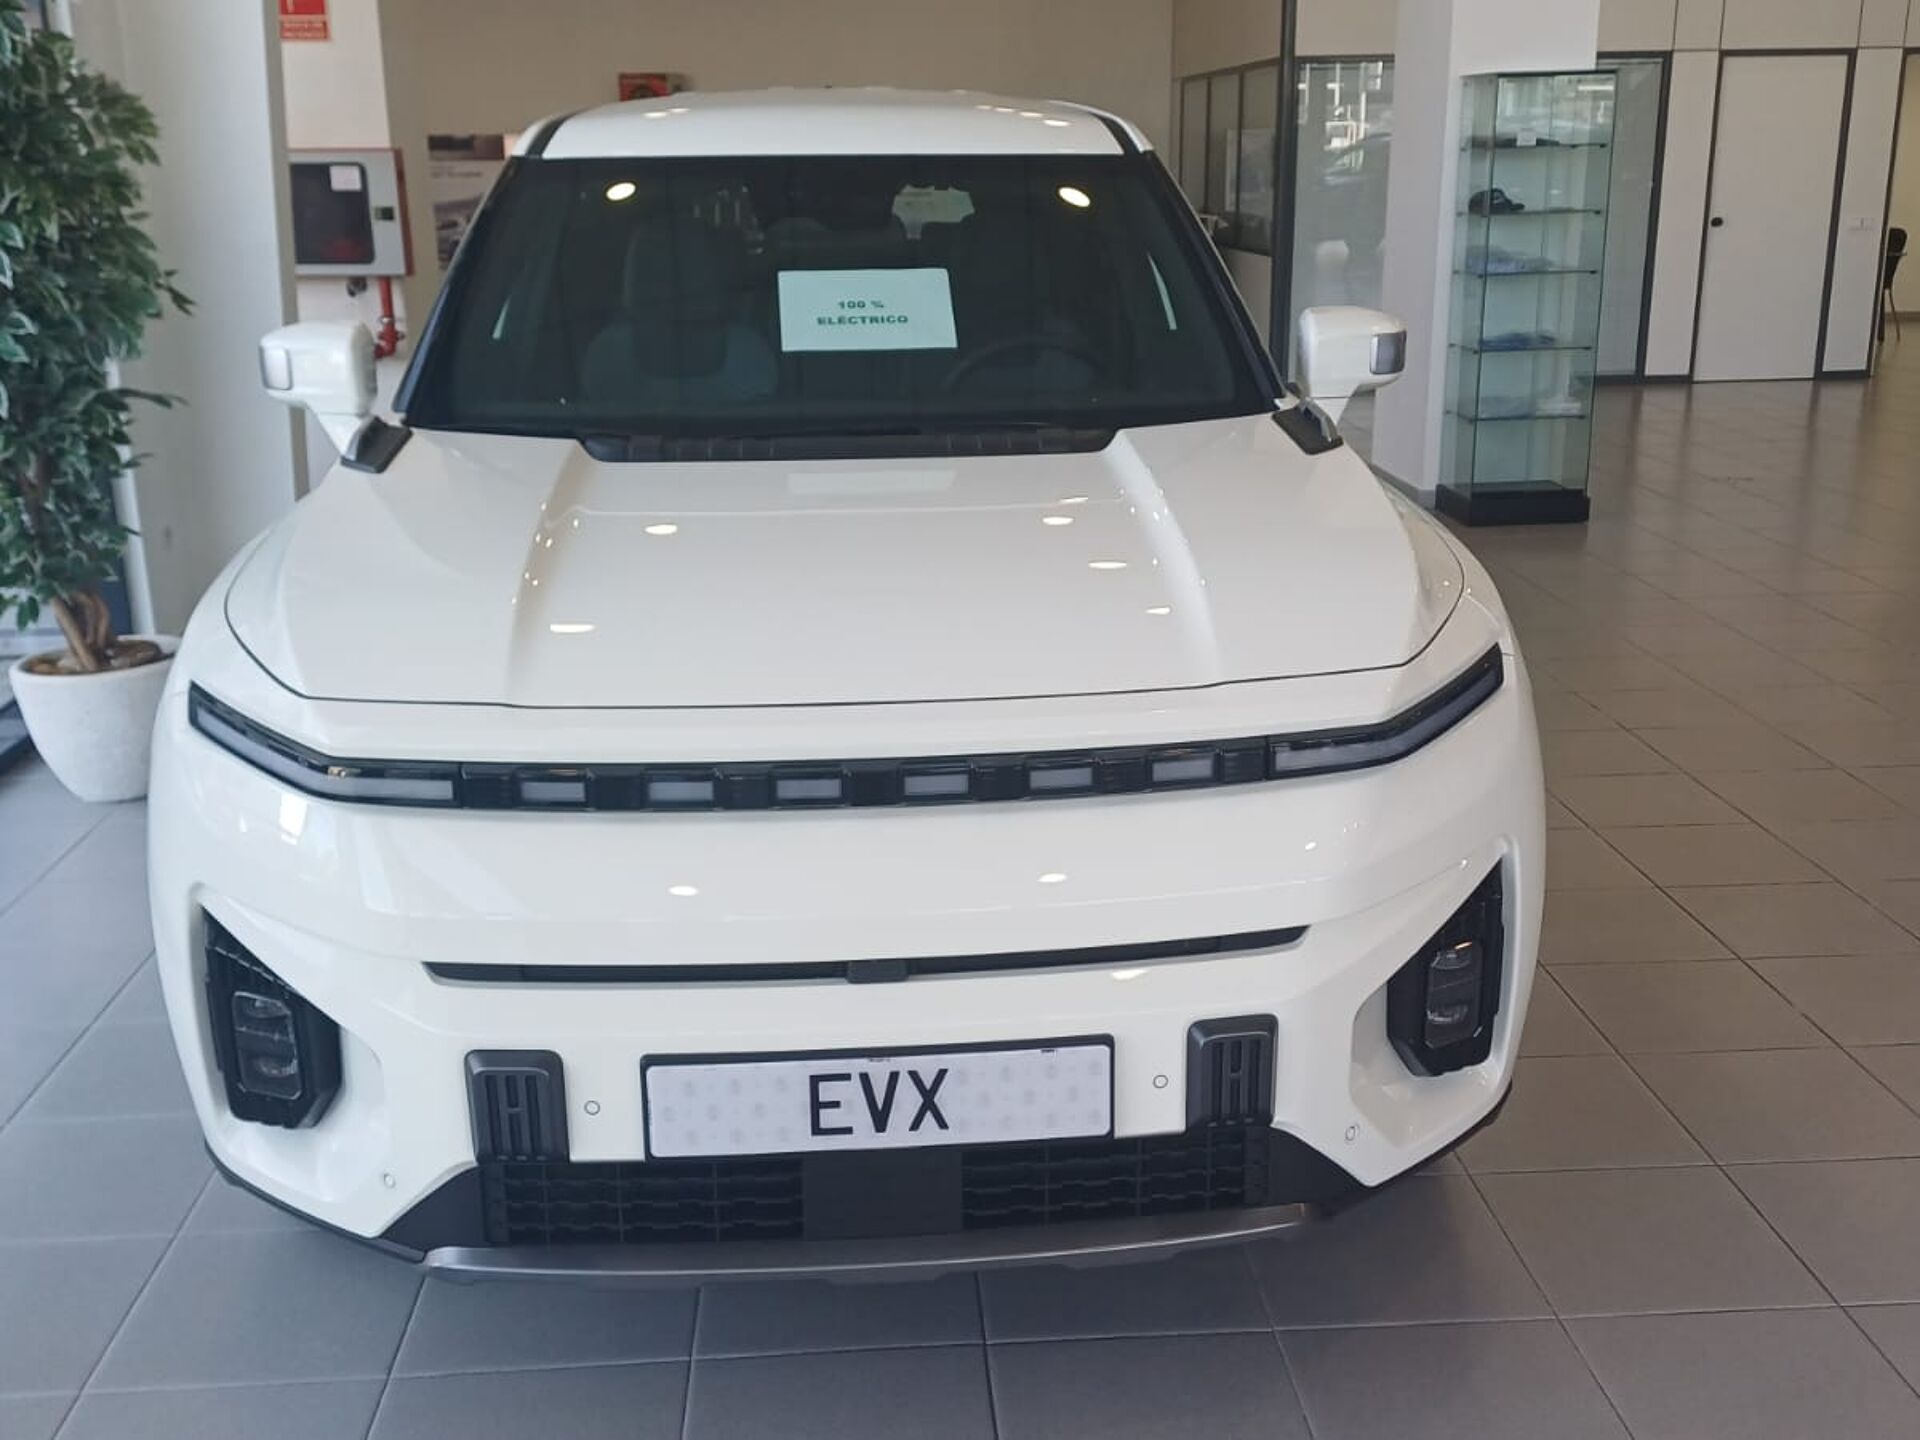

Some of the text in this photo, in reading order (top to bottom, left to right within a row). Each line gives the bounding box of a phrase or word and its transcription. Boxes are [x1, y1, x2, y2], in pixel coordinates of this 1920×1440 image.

[838, 300, 884, 309] 100 %
[809, 1068, 949, 1136] EVX
